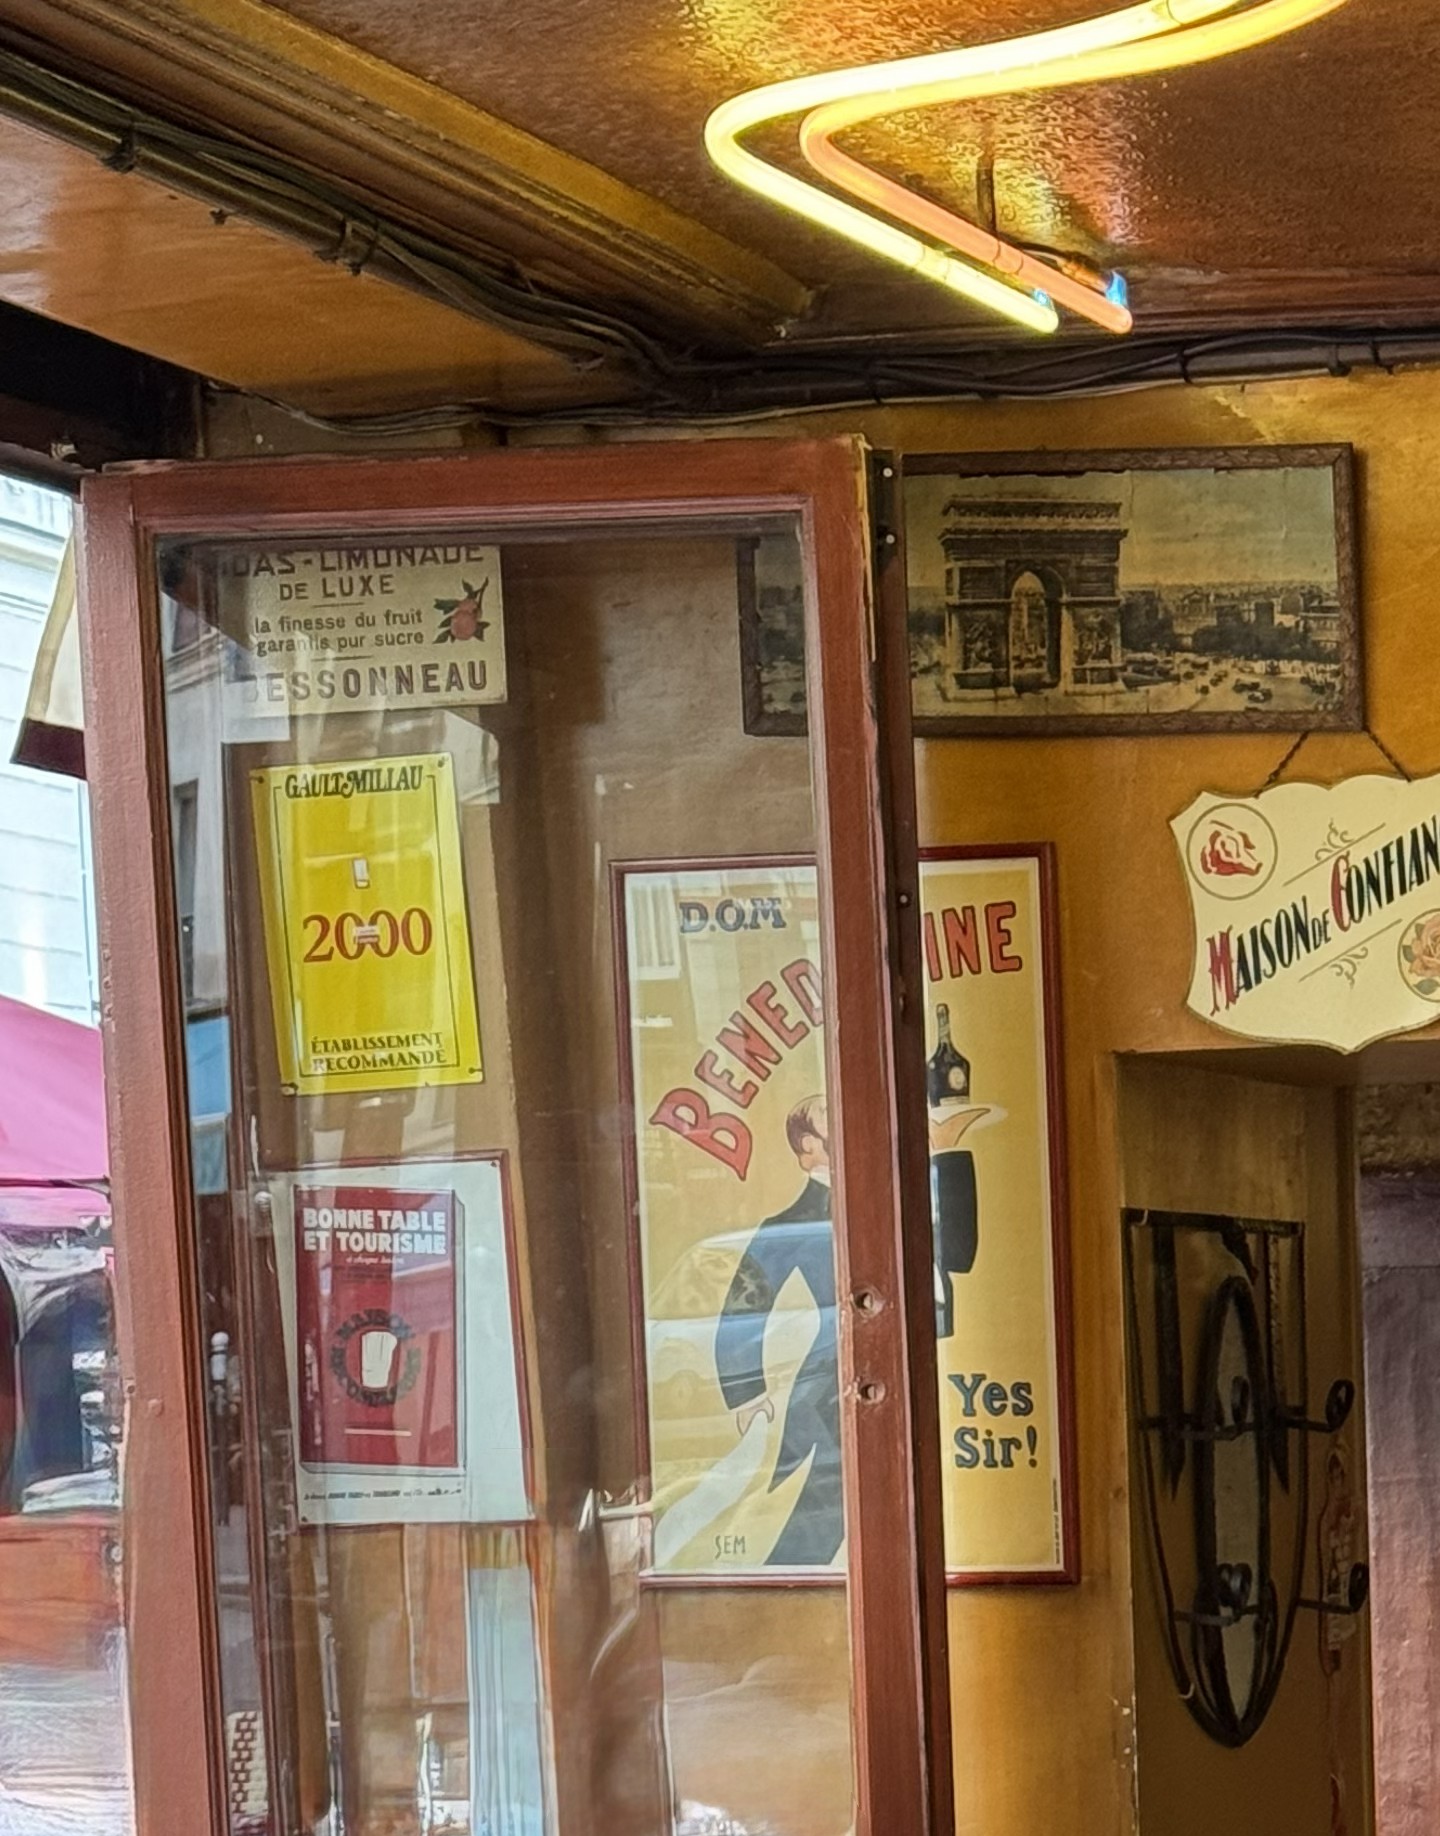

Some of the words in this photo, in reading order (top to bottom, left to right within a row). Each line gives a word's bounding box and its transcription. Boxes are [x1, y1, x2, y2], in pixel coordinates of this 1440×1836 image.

[278, 583, 309, 601] DE
[322, 573, 395, 599] LUXE
[254, 616, 271, 634] la
[278, 614, 346, 633] finesse
[355, 611, 376, 628] du
[384, 608, 423, 626] fruit
[337, 635, 365, 652] pur
[374, 631, 424, 648] sucre
[246, 659, 488, 703] ESSONNEAU
[303, 907, 433, 963] 2000
[1205, 895, 1312, 1017] MAISON
[1310, 908, 1332, 951] DE
[303, 1207, 375, 1230] BONNE
[377, 1209, 446, 1232] TABLE
[304, 1231, 330, 1251] ET
[336, 1231, 447, 1255] TOURISME
[947, 1374, 1035, 1418] Yes
[953, 1425, 1038, 1469] Sir!
[714, 1534, 747, 1559] SEM
